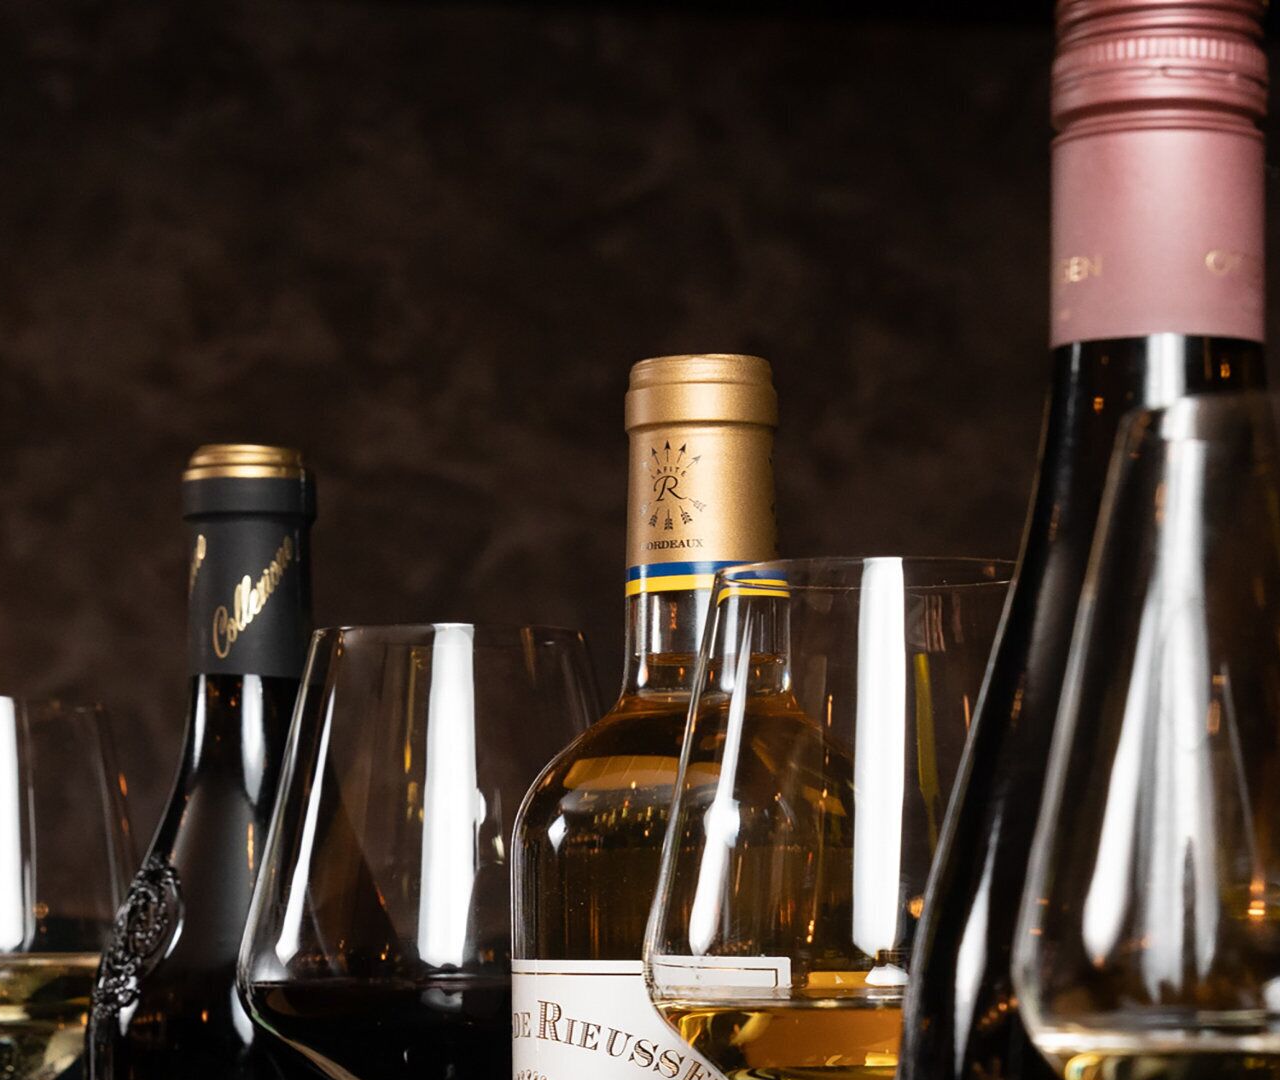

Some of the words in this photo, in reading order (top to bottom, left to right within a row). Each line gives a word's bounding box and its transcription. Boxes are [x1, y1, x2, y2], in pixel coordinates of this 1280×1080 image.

[650, 465, 687, 480] LAFITE
[653, 475, 688, 502] R
[640, 539, 703, 550] BORDEAUX
